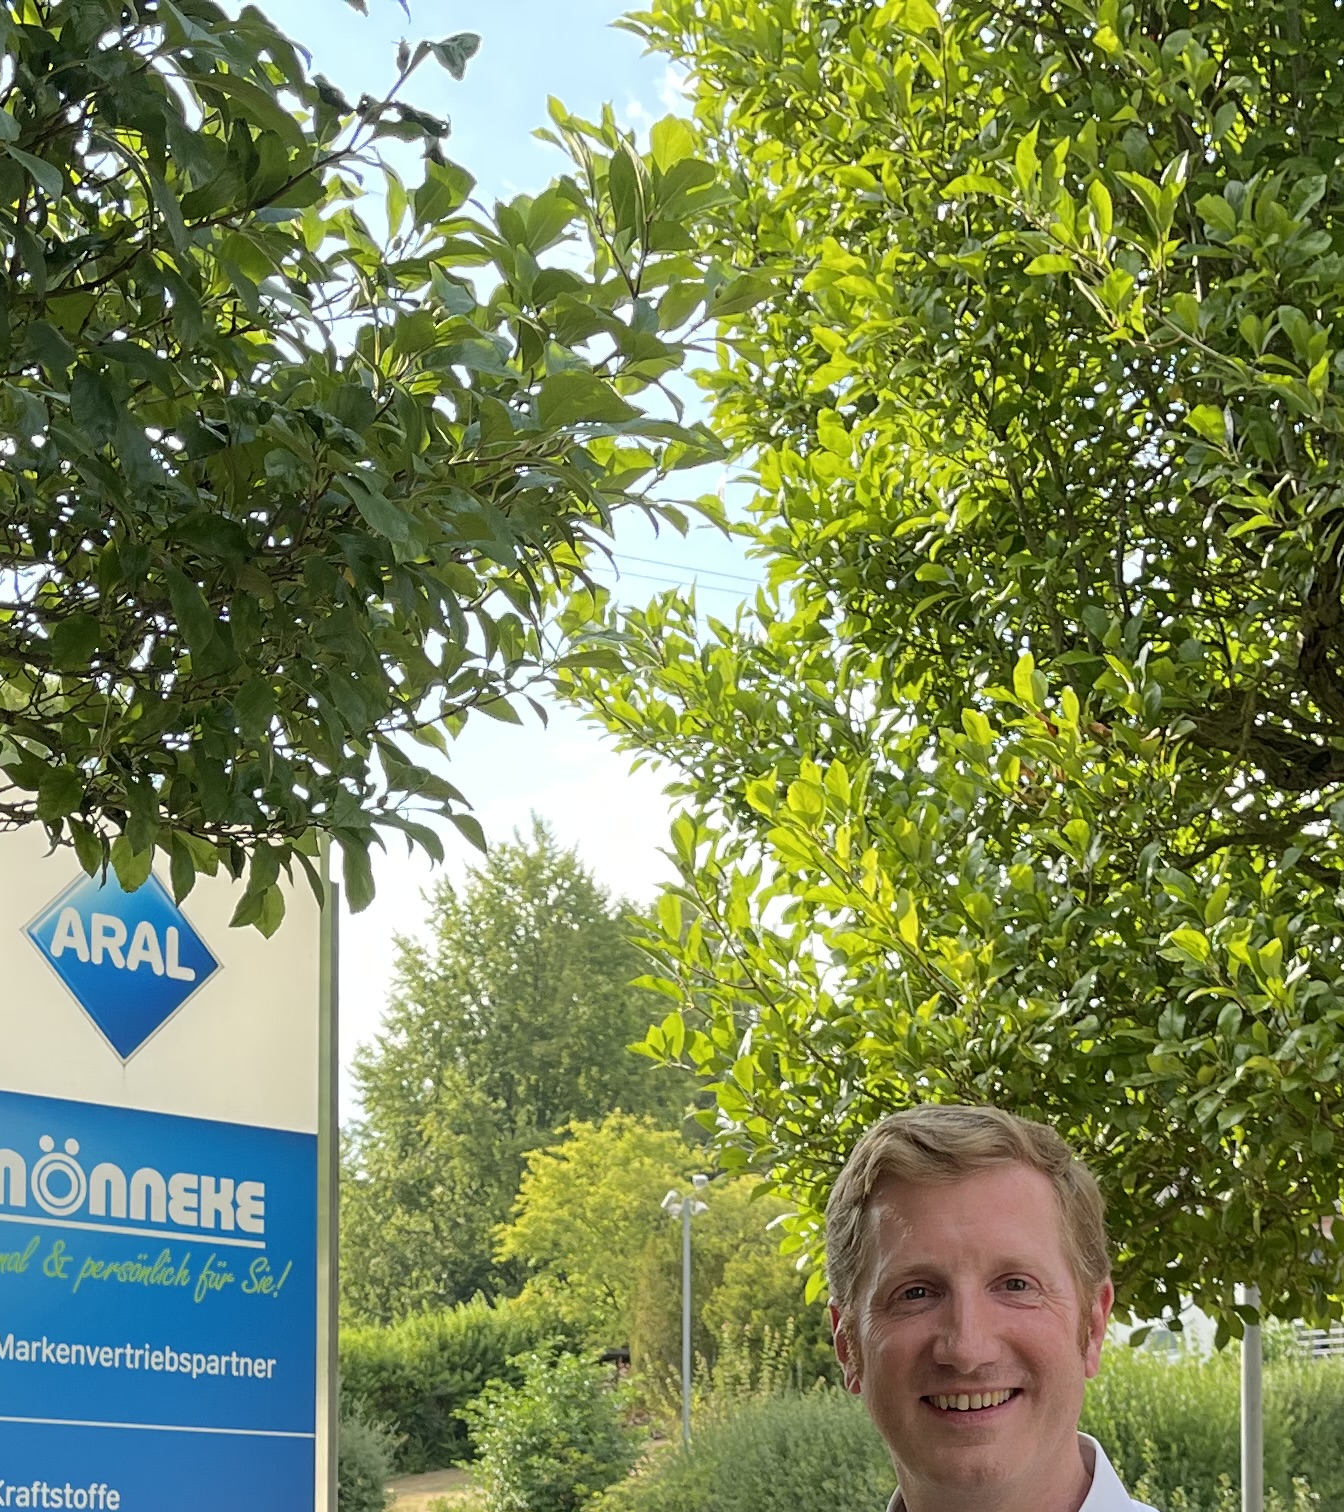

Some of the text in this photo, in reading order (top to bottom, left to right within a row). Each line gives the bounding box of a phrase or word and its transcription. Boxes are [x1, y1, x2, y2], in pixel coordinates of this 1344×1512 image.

[50, 906, 196, 982] ARAL
[42, 1239, 74, 1279] &
[72, 1248, 190, 1294] persönlich
[194, 1253, 235, 1304] für
[241, 1256, 293, 1298] Sie!
